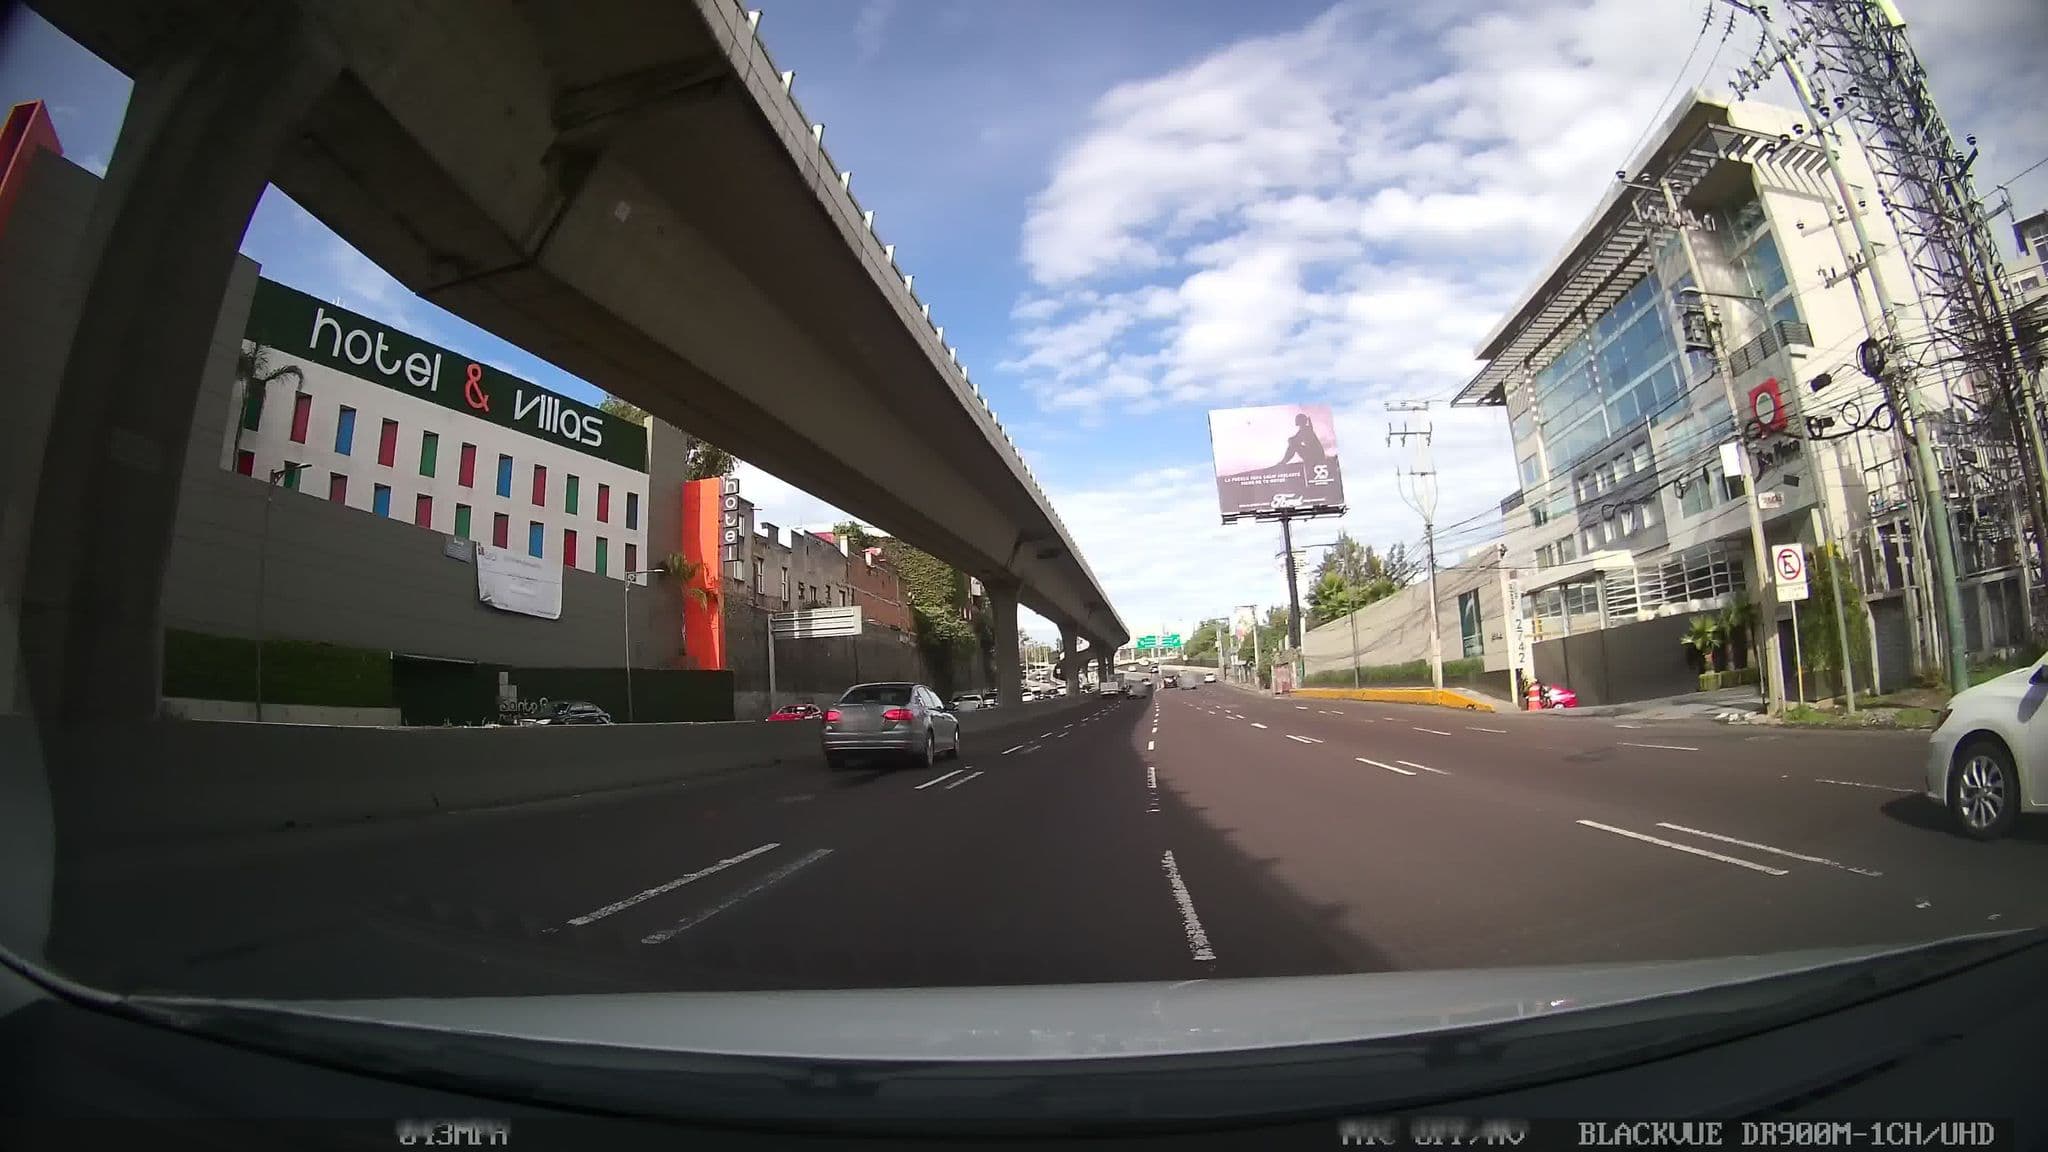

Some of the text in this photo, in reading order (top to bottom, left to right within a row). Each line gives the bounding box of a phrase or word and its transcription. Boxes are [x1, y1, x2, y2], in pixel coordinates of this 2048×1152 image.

[309, 306, 605, 448] hotel & villas
[724, 479, 737, 561] hotel
[1515, 619, 1526, 663] 2742
